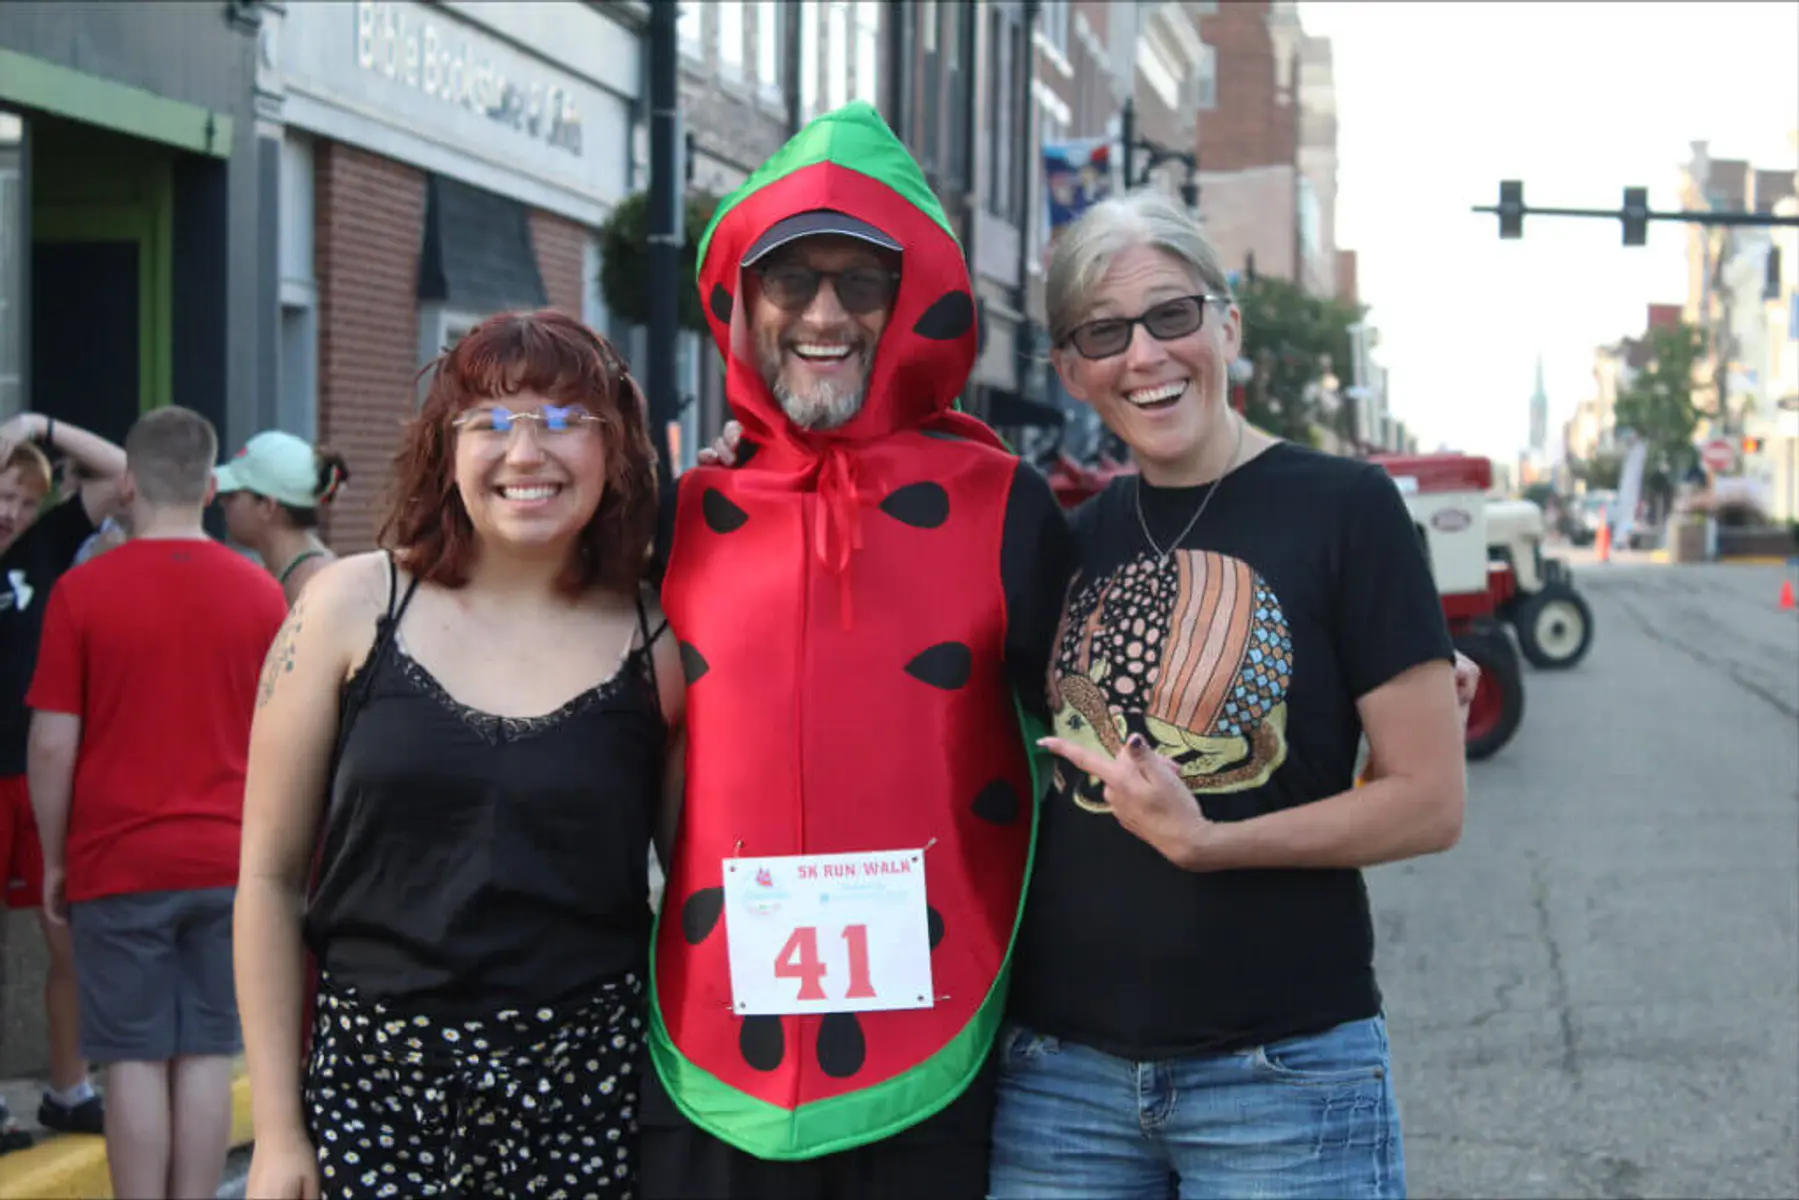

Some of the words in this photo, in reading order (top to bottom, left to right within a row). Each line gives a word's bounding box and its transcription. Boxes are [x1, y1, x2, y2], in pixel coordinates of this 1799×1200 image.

[357, 1, 418, 88] Bible
[798, 864, 818, 879] 5K
[824, 863, 856, 877] RUN
[863, 859, 911, 875] WALK
[774, 924, 877, 1001] 41
